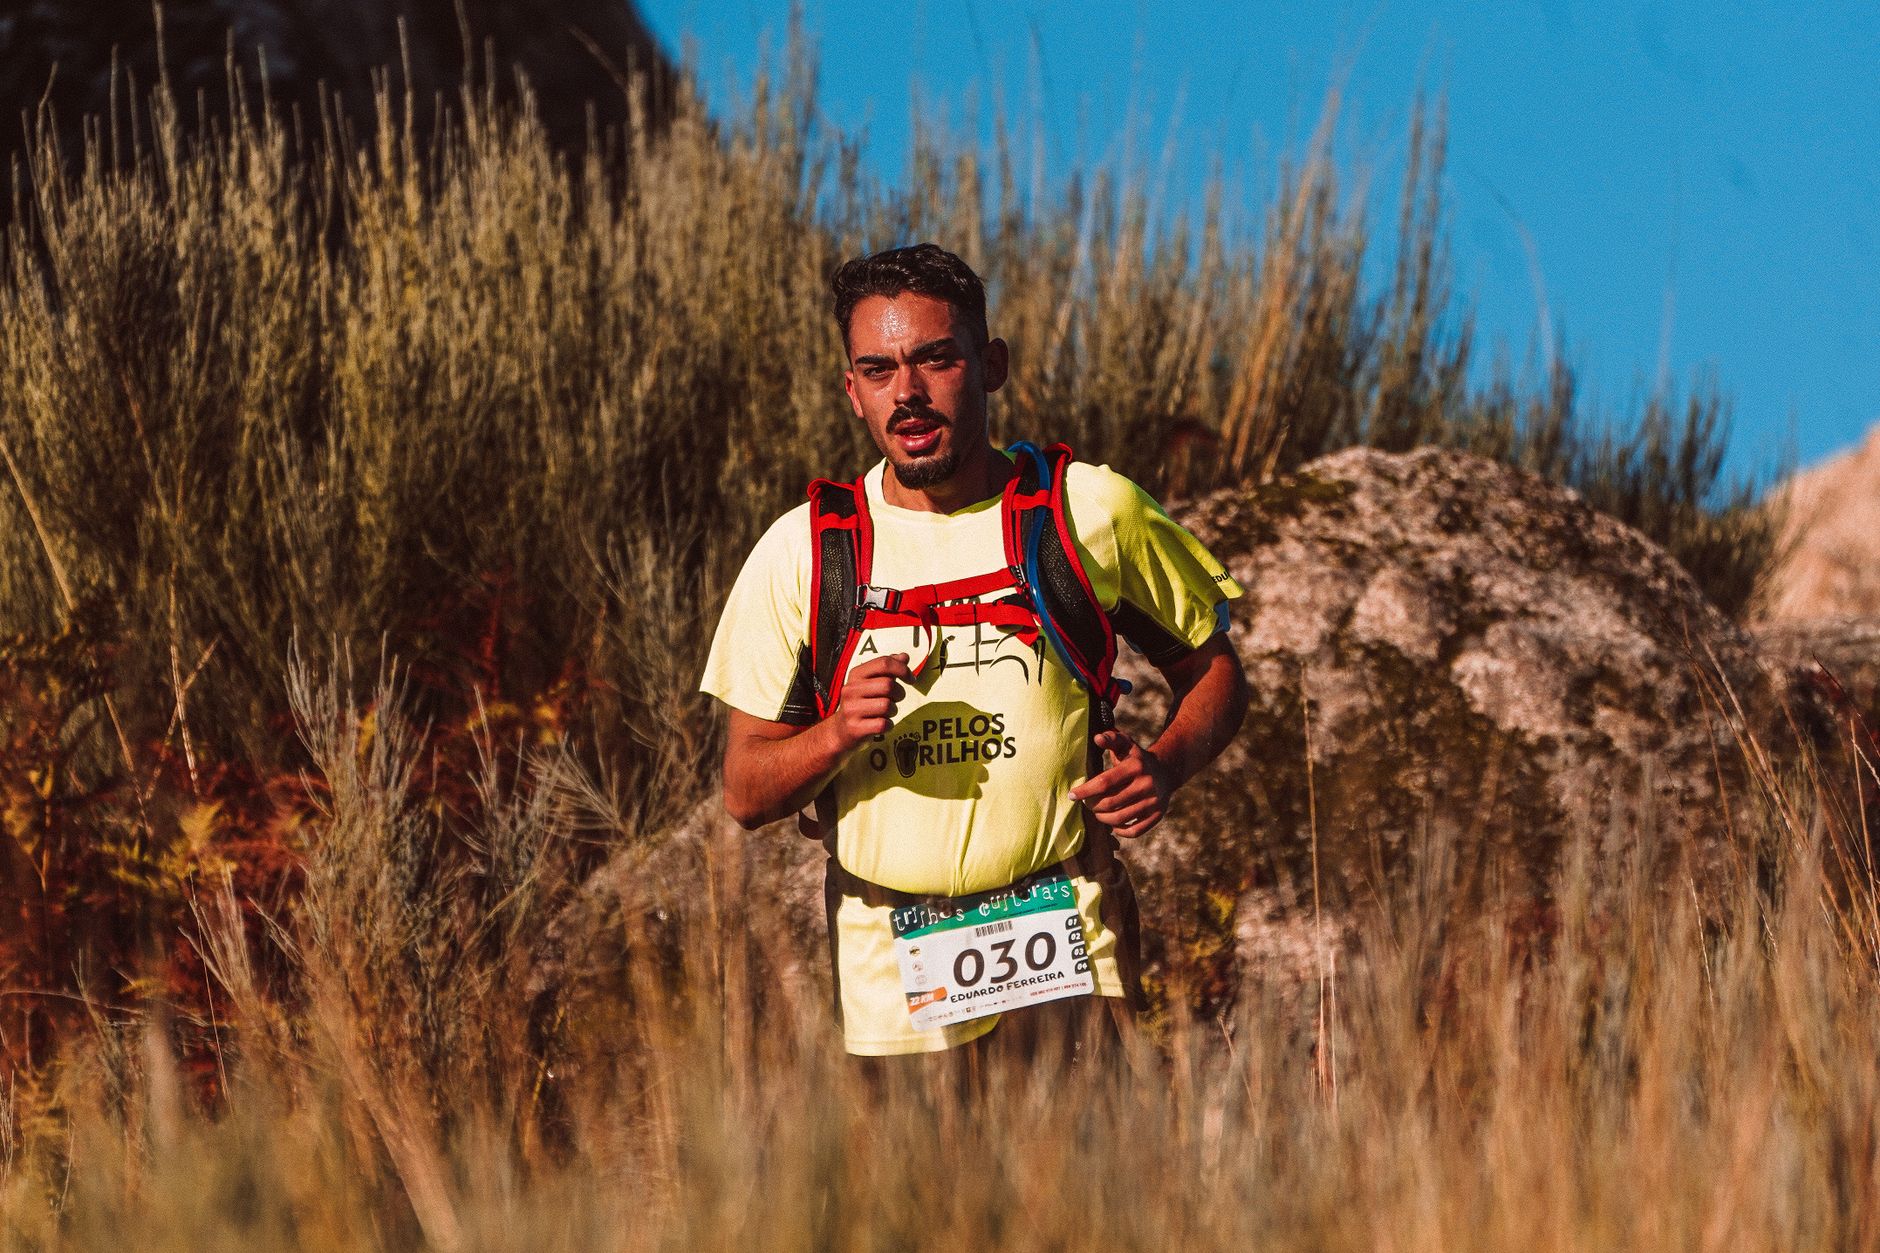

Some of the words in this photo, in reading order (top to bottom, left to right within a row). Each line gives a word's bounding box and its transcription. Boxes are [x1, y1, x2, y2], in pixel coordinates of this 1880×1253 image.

[922, 713, 1005, 741] PELOS
[1067, 918, 1077, 926] 01
[1070, 933, 1081, 941] 02
[953, 931, 1056, 987] 030
[1074, 947, 1084, 956] 03
[950, 985, 1003, 1003] EDUARDO
[1006, 971, 1065, 990] FERREIRA
